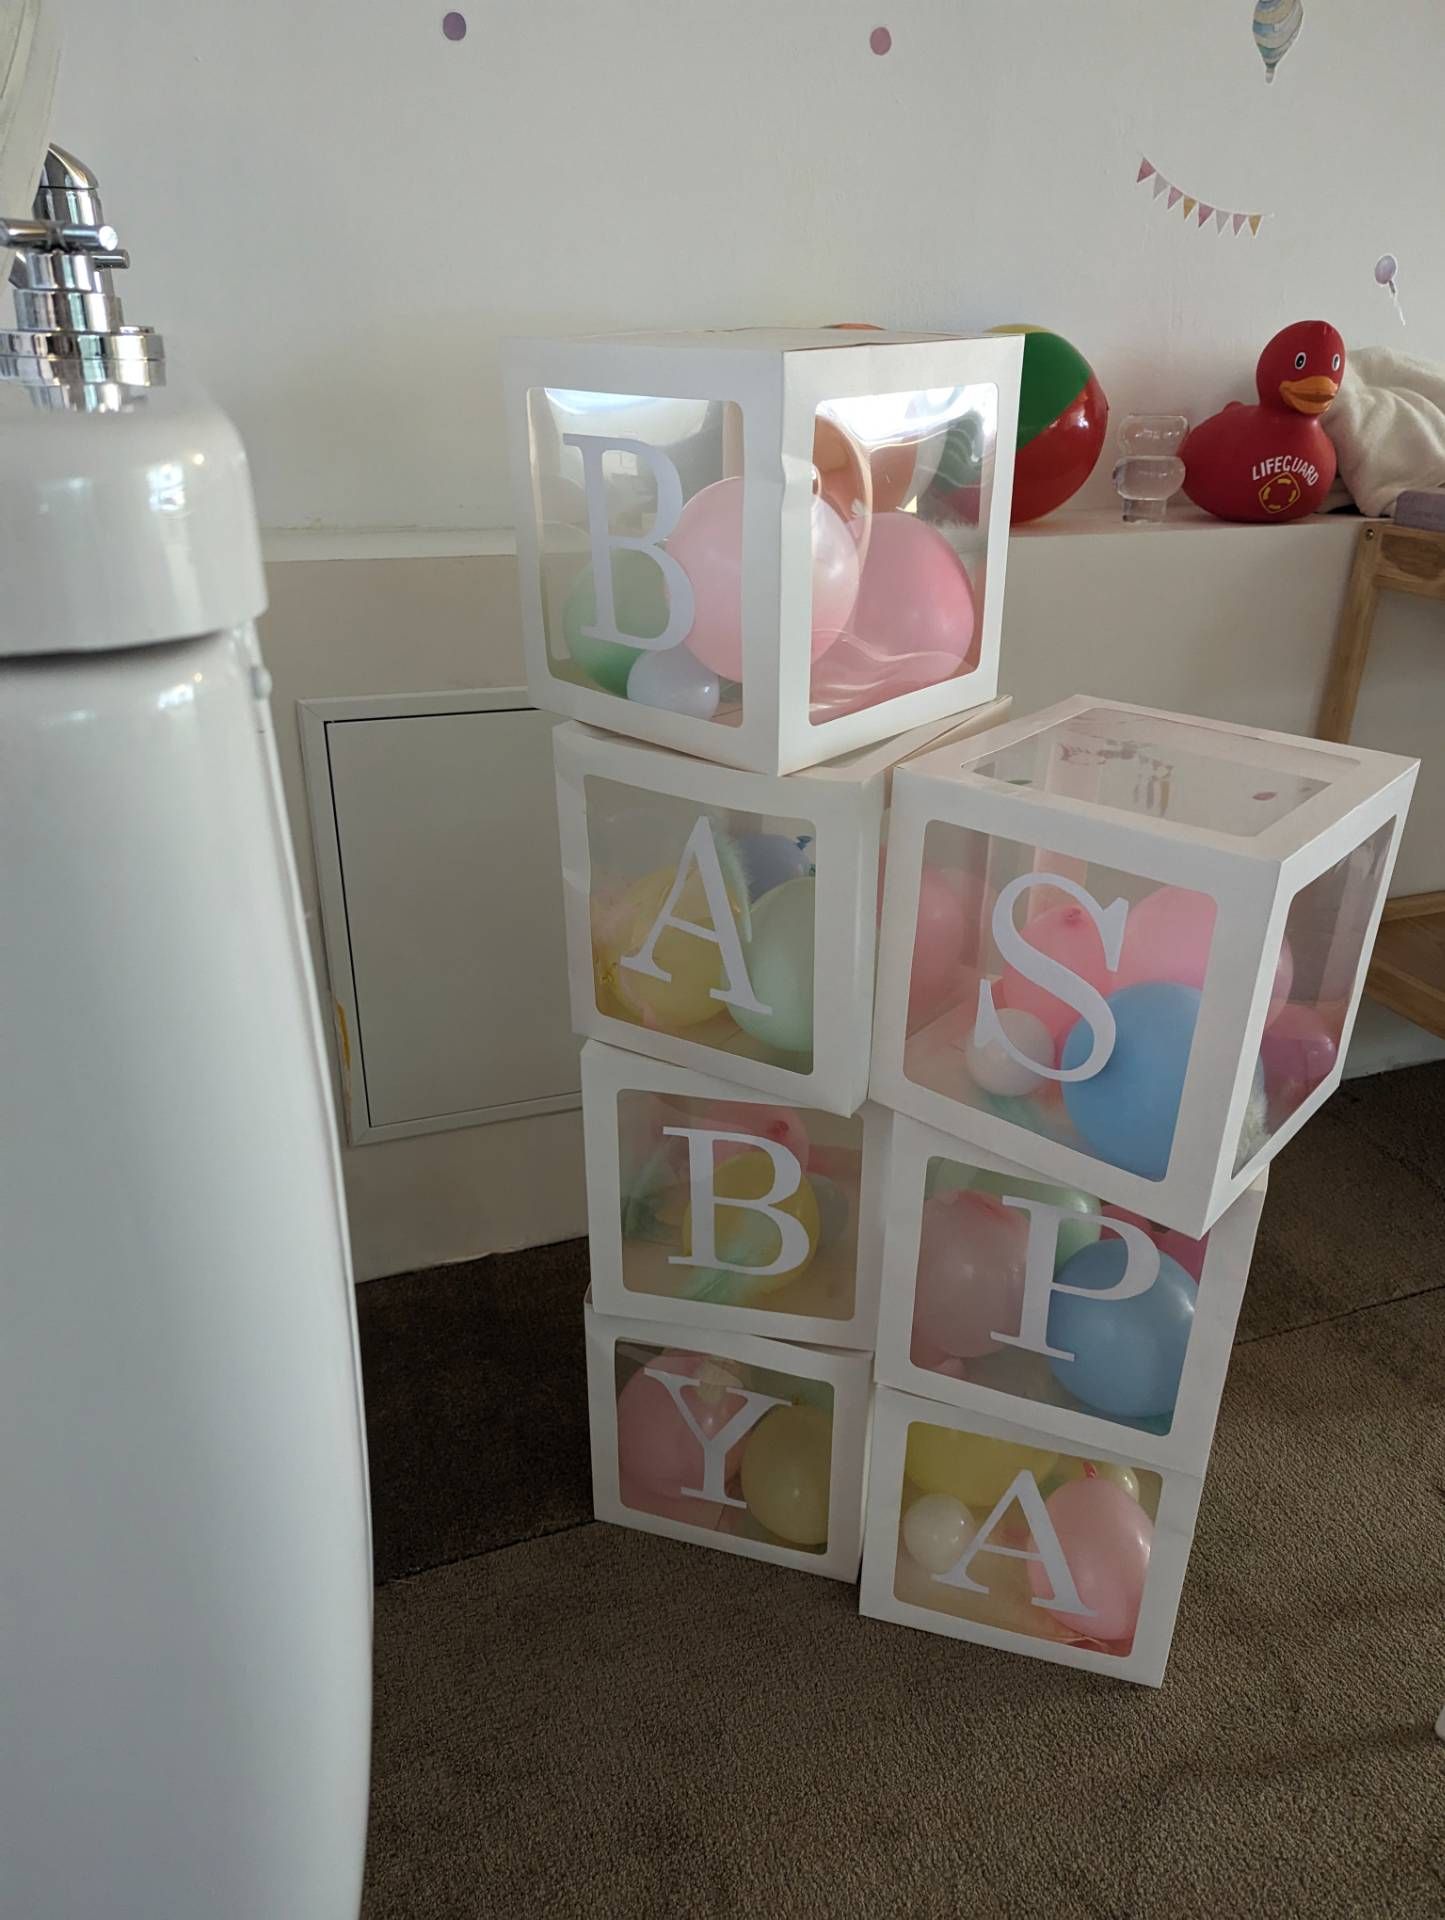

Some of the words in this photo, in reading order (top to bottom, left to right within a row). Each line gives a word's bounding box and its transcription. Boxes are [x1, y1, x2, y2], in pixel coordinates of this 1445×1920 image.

[620, 815, 773, 1016] A
[973, 872, 1128, 1082] S
[662, 1126, 810, 1276] B
[989, 1194, 1161, 1362] P
[643, 1367, 792, 1509] Y
[931, 1469, 1098, 1617] A
